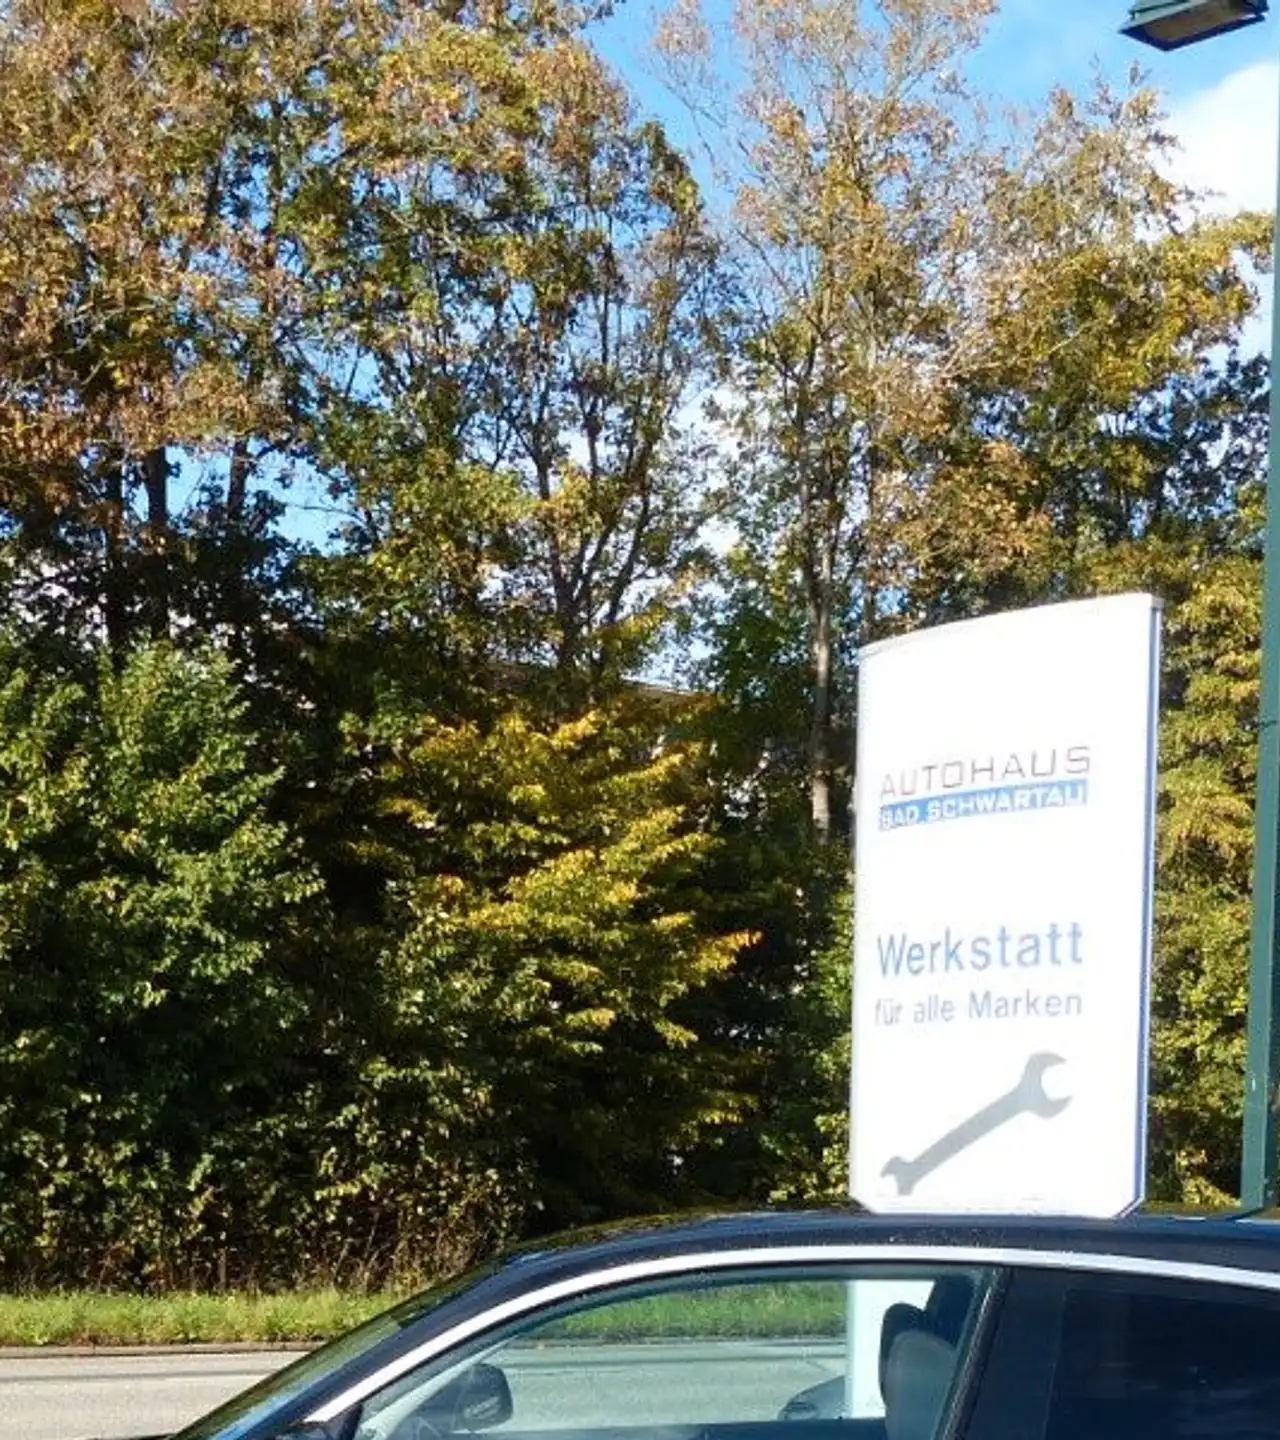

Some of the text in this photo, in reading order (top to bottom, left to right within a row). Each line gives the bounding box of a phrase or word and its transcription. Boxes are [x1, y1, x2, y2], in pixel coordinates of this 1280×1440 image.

[879, 745, 1090, 800] AUTOHAUS
[880, 788, 1083, 830] BAD SCHWARTAU
[876, 922, 1083, 978] Werkstatt
[874, 988, 1083, 1027] für alle Marken
